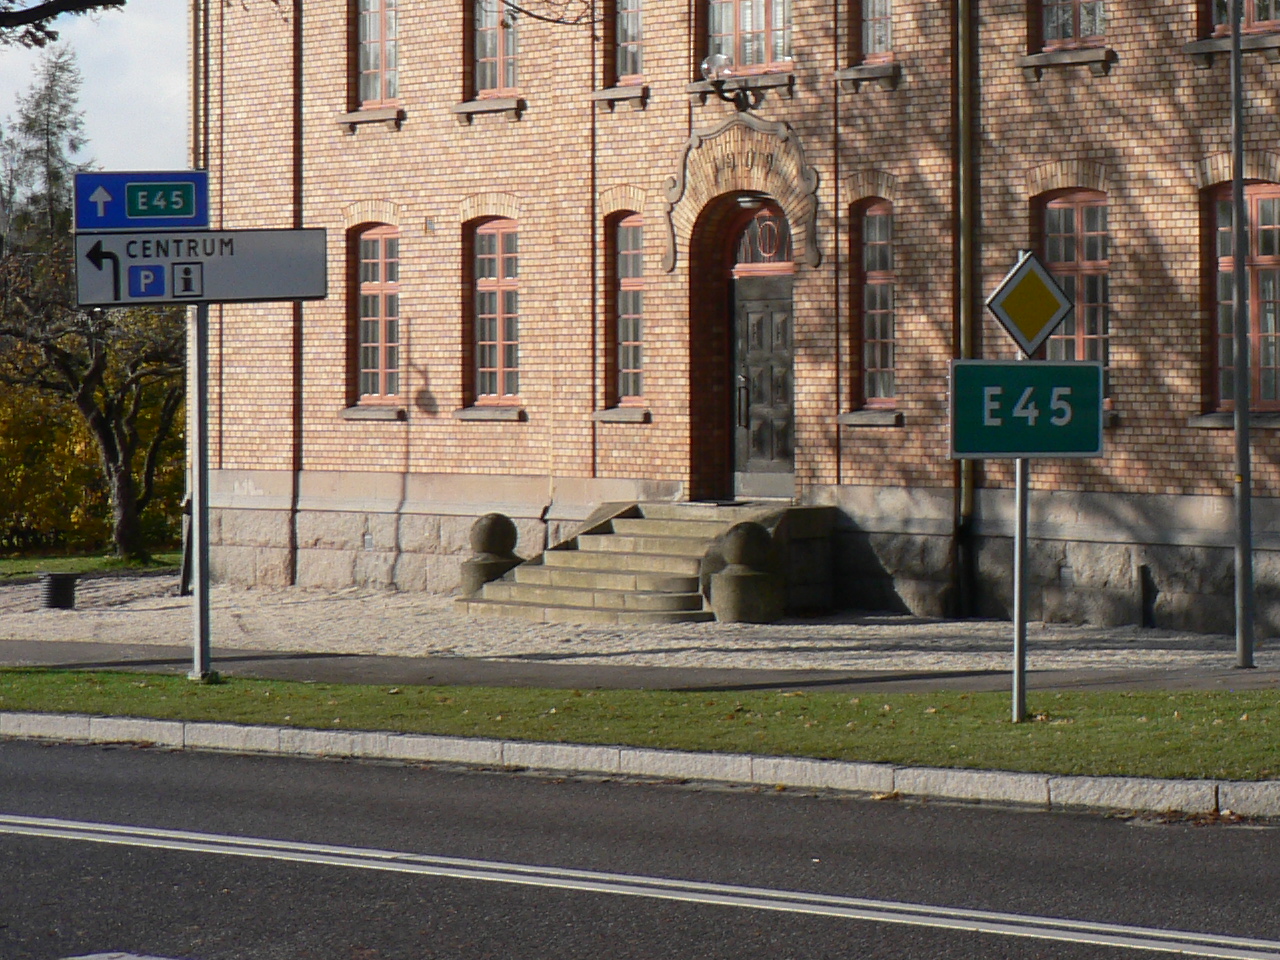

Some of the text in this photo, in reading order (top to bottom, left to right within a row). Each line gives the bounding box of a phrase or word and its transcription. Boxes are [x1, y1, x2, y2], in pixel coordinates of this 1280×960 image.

[137, 190, 184, 210] E45
[126, 238, 234, 258] CENTRUM
[140, 270, 154, 292] P
[983, 387, 1072, 427] E45
